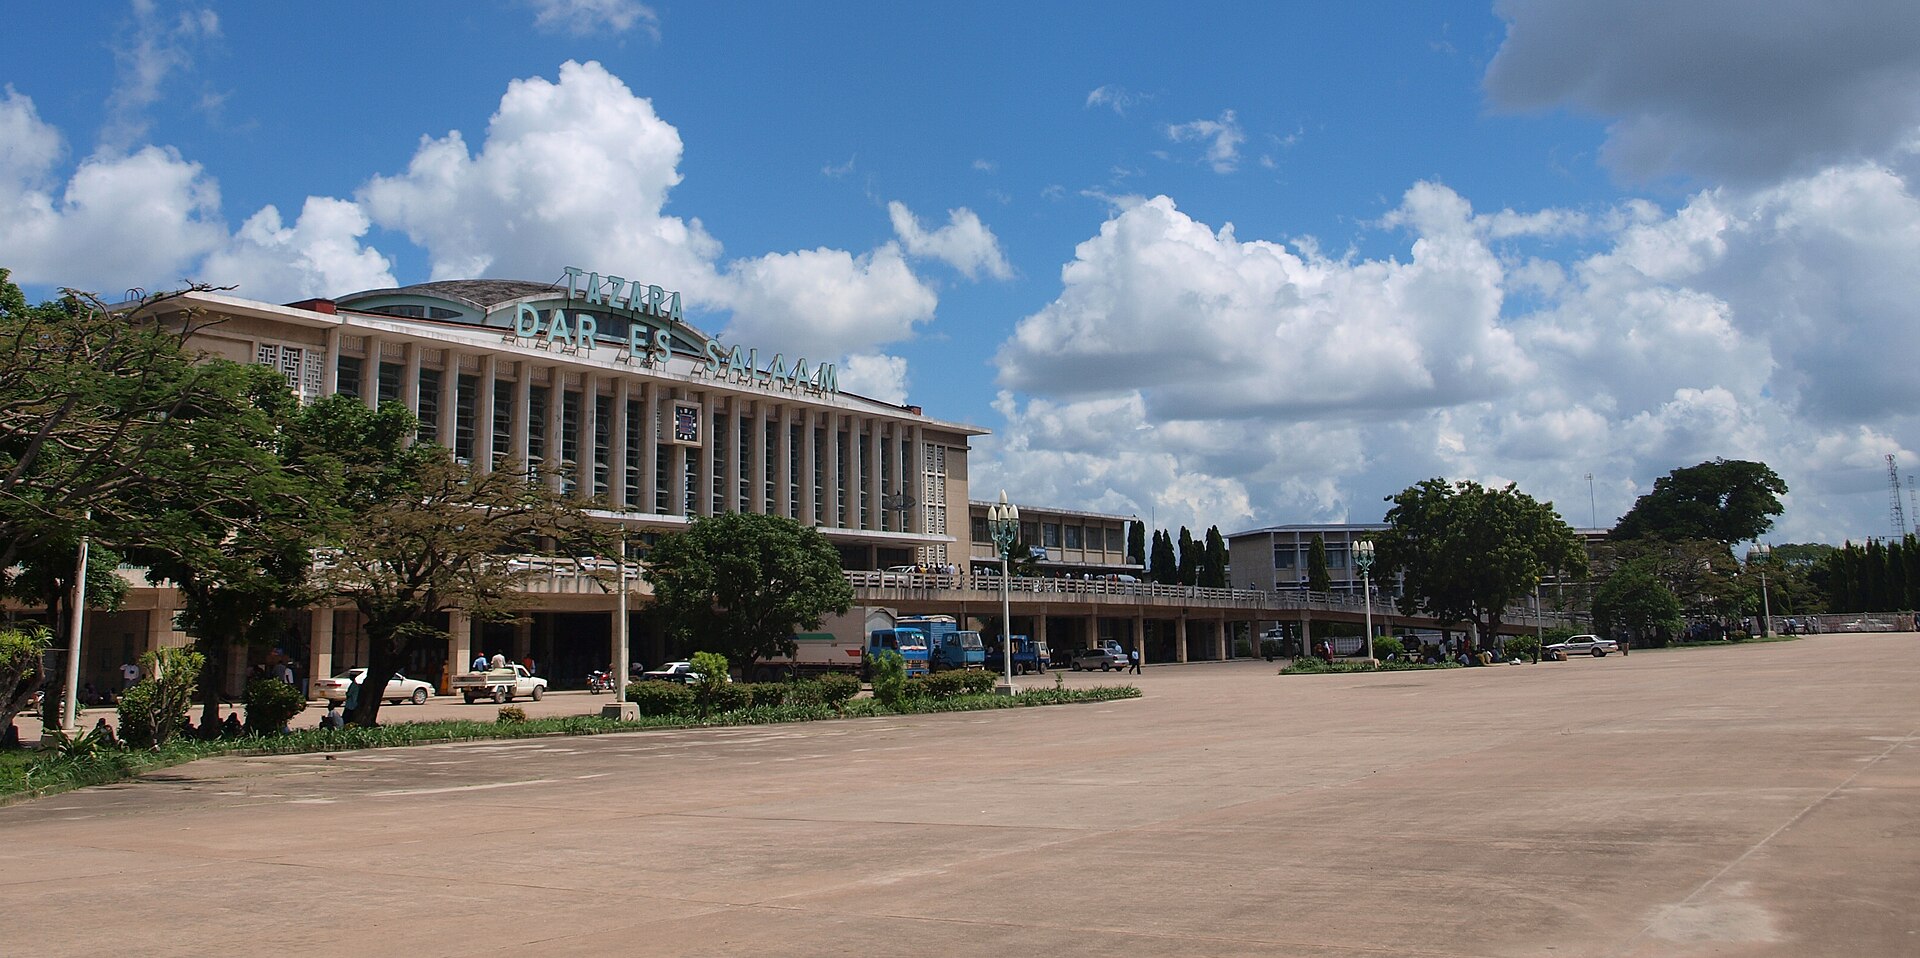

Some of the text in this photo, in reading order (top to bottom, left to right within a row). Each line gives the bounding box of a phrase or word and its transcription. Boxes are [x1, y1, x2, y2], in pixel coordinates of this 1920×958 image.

[564, 267, 684, 322] TAZARA
[516, 302, 839, 394] DAR ES SALAAM
